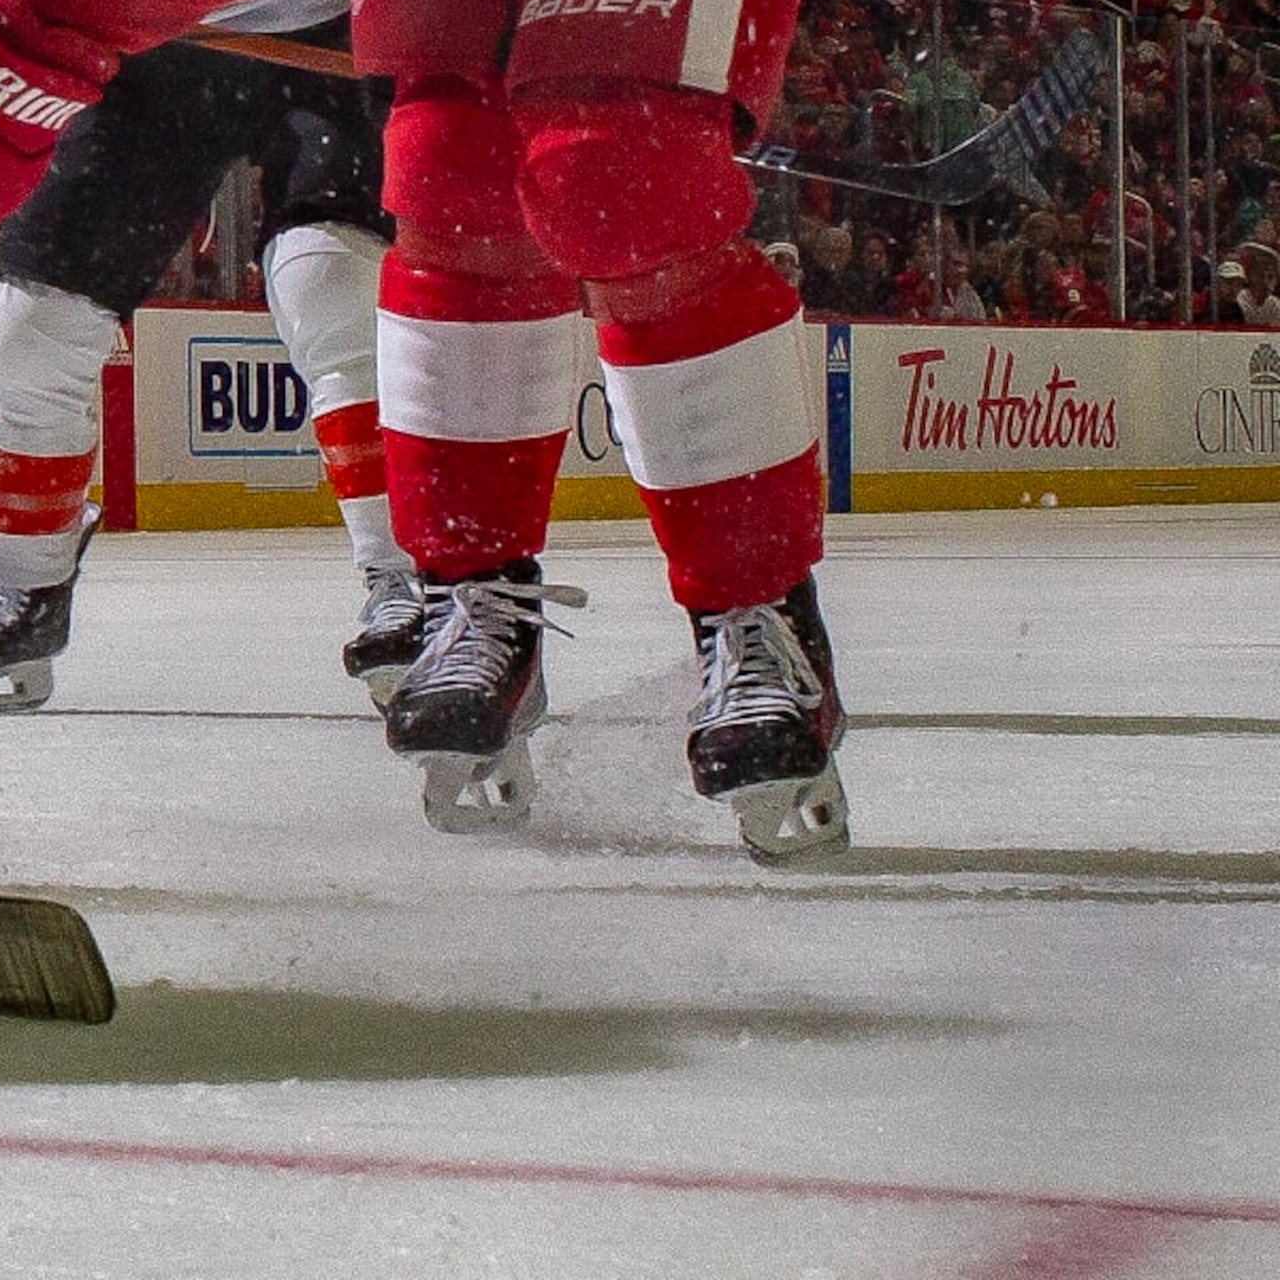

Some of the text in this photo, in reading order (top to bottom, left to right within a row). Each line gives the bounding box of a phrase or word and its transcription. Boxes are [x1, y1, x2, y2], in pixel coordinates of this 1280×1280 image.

[200, 360, 308, 433] BUD
[897, 344, 1118, 452] Tim Hortons
